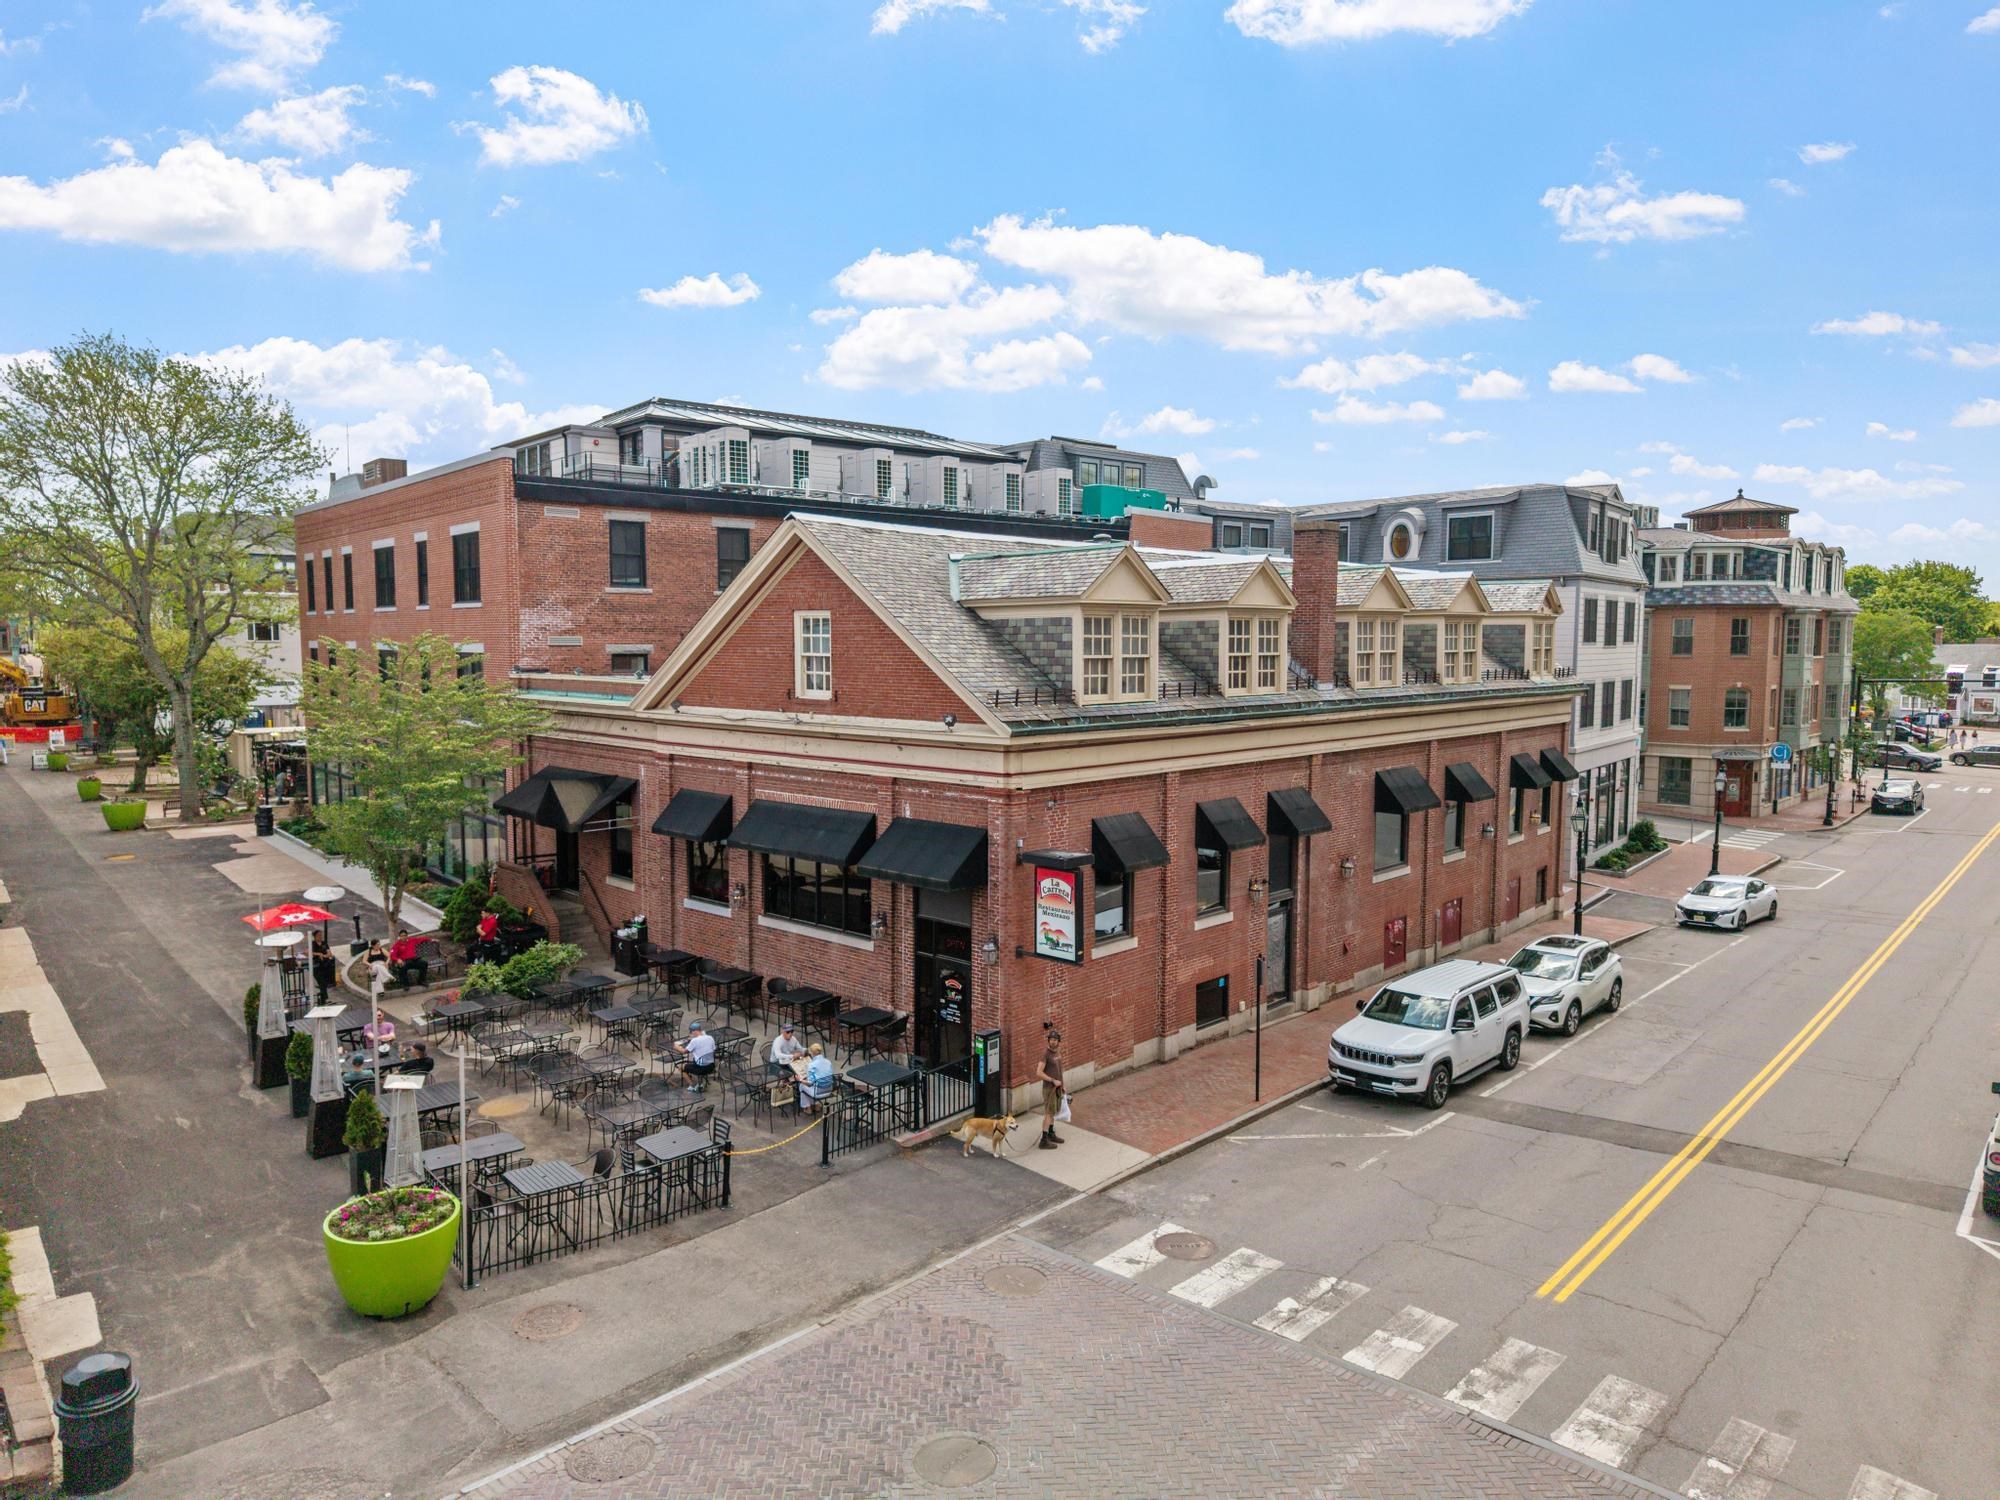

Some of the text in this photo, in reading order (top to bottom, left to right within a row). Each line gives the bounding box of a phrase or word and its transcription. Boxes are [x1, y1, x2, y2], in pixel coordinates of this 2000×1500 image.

[25, 700, 45, 712] CAT
[1051, 879, 1060, 887] La
[1043, 885, 1070, 898] Carreta
[1038, 903, 1074, 915] Restaurante
[1042, 910, 1071, 920] Mexicano
